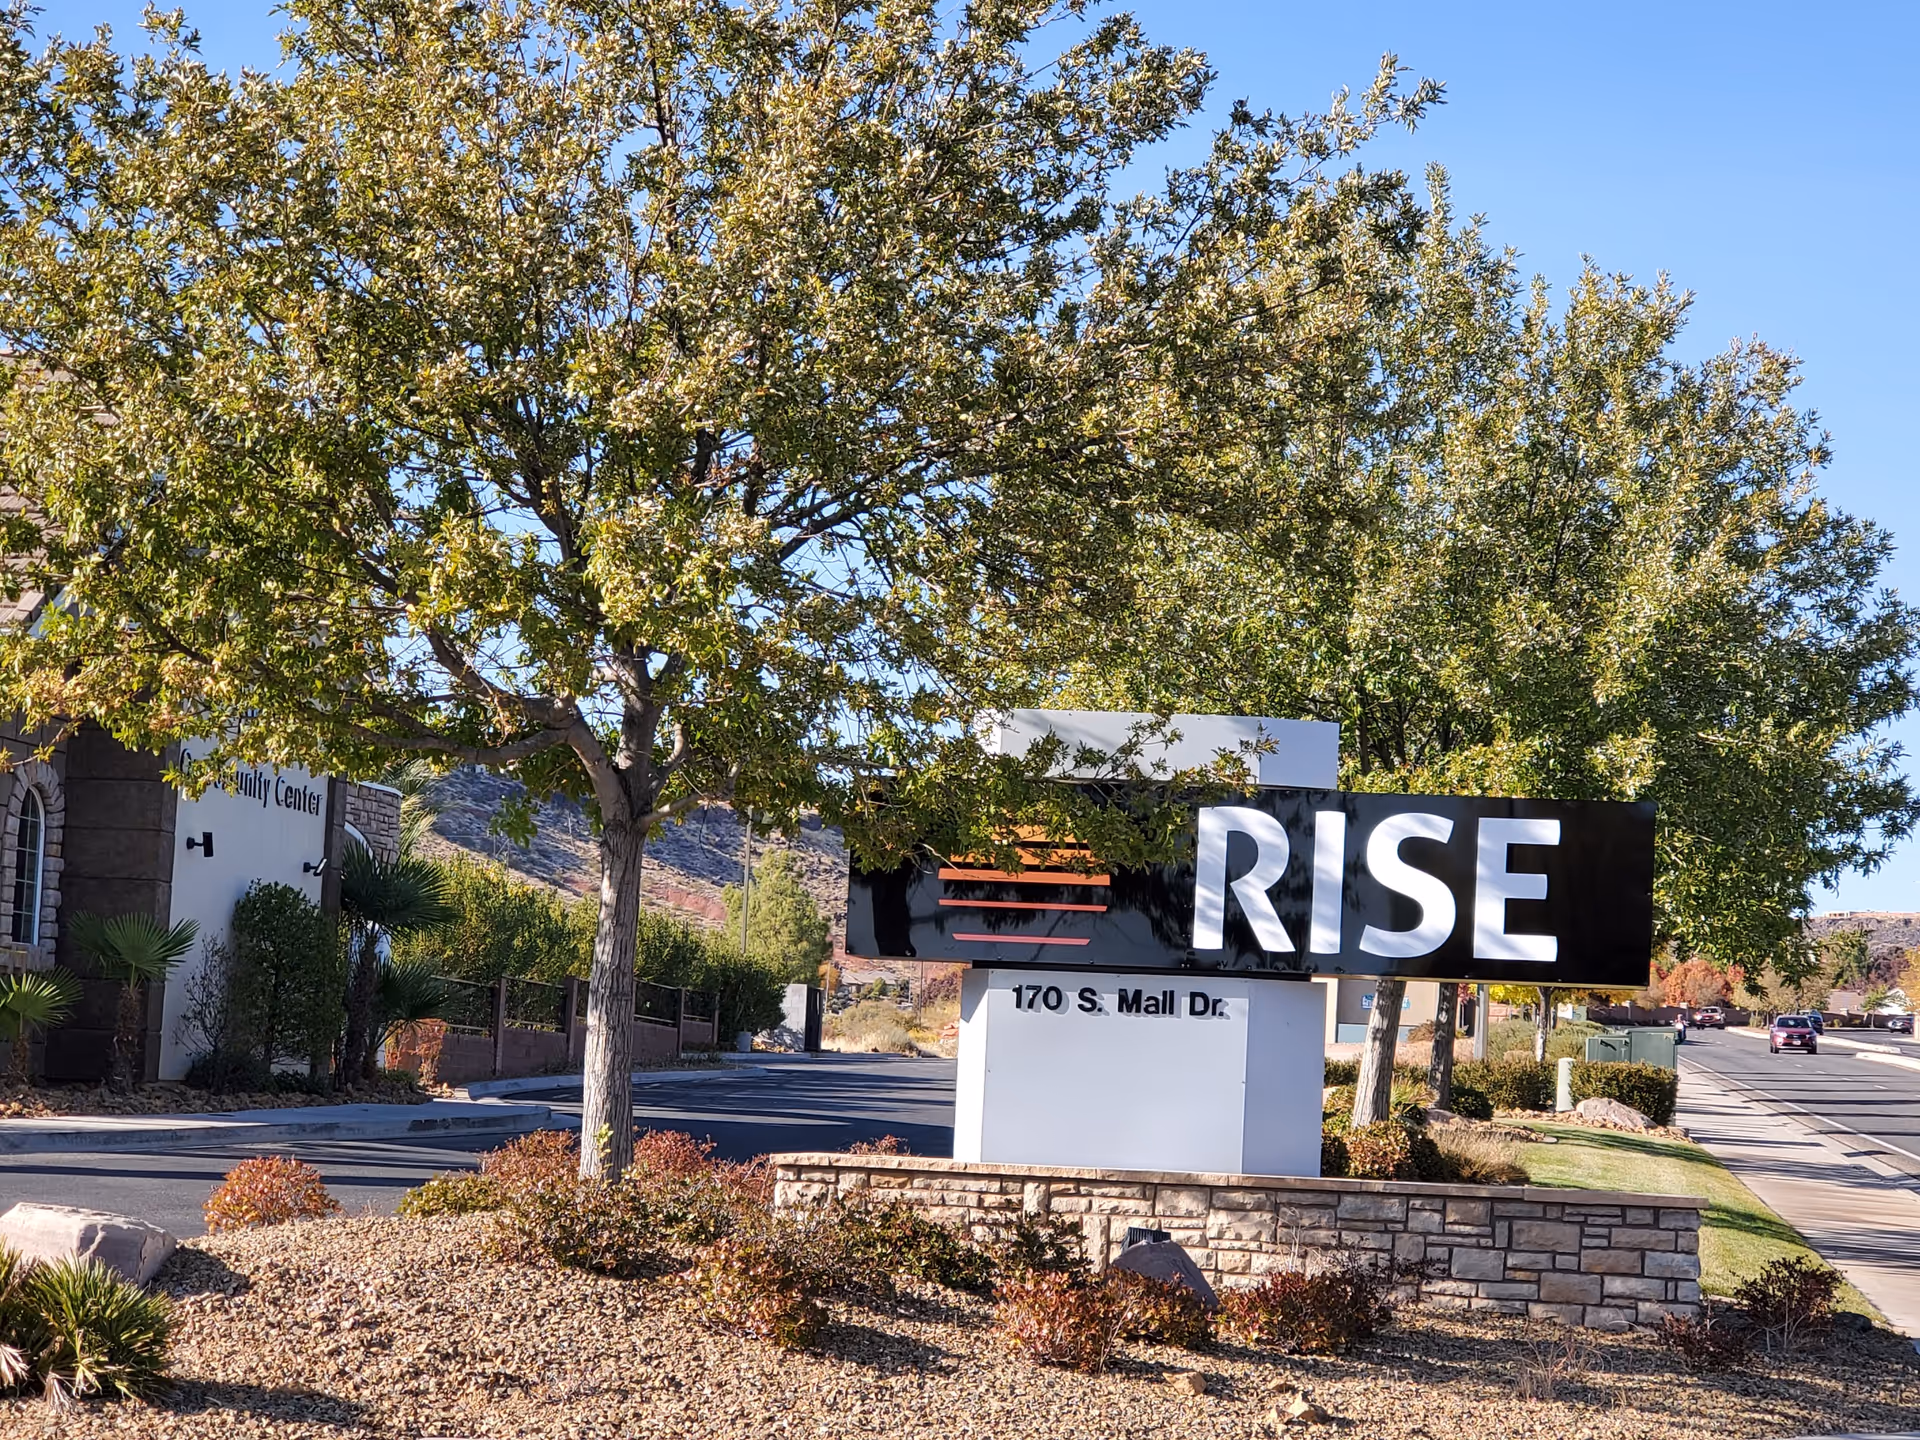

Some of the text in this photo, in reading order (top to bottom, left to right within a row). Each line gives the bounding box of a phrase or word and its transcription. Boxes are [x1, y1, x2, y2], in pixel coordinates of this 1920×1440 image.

[180, 748, 323, 816] Cunity Center
[1192, 805, 1561, 962] RISE
[1012, 984, 1225, 1017] 170 S. Mall Dr.
